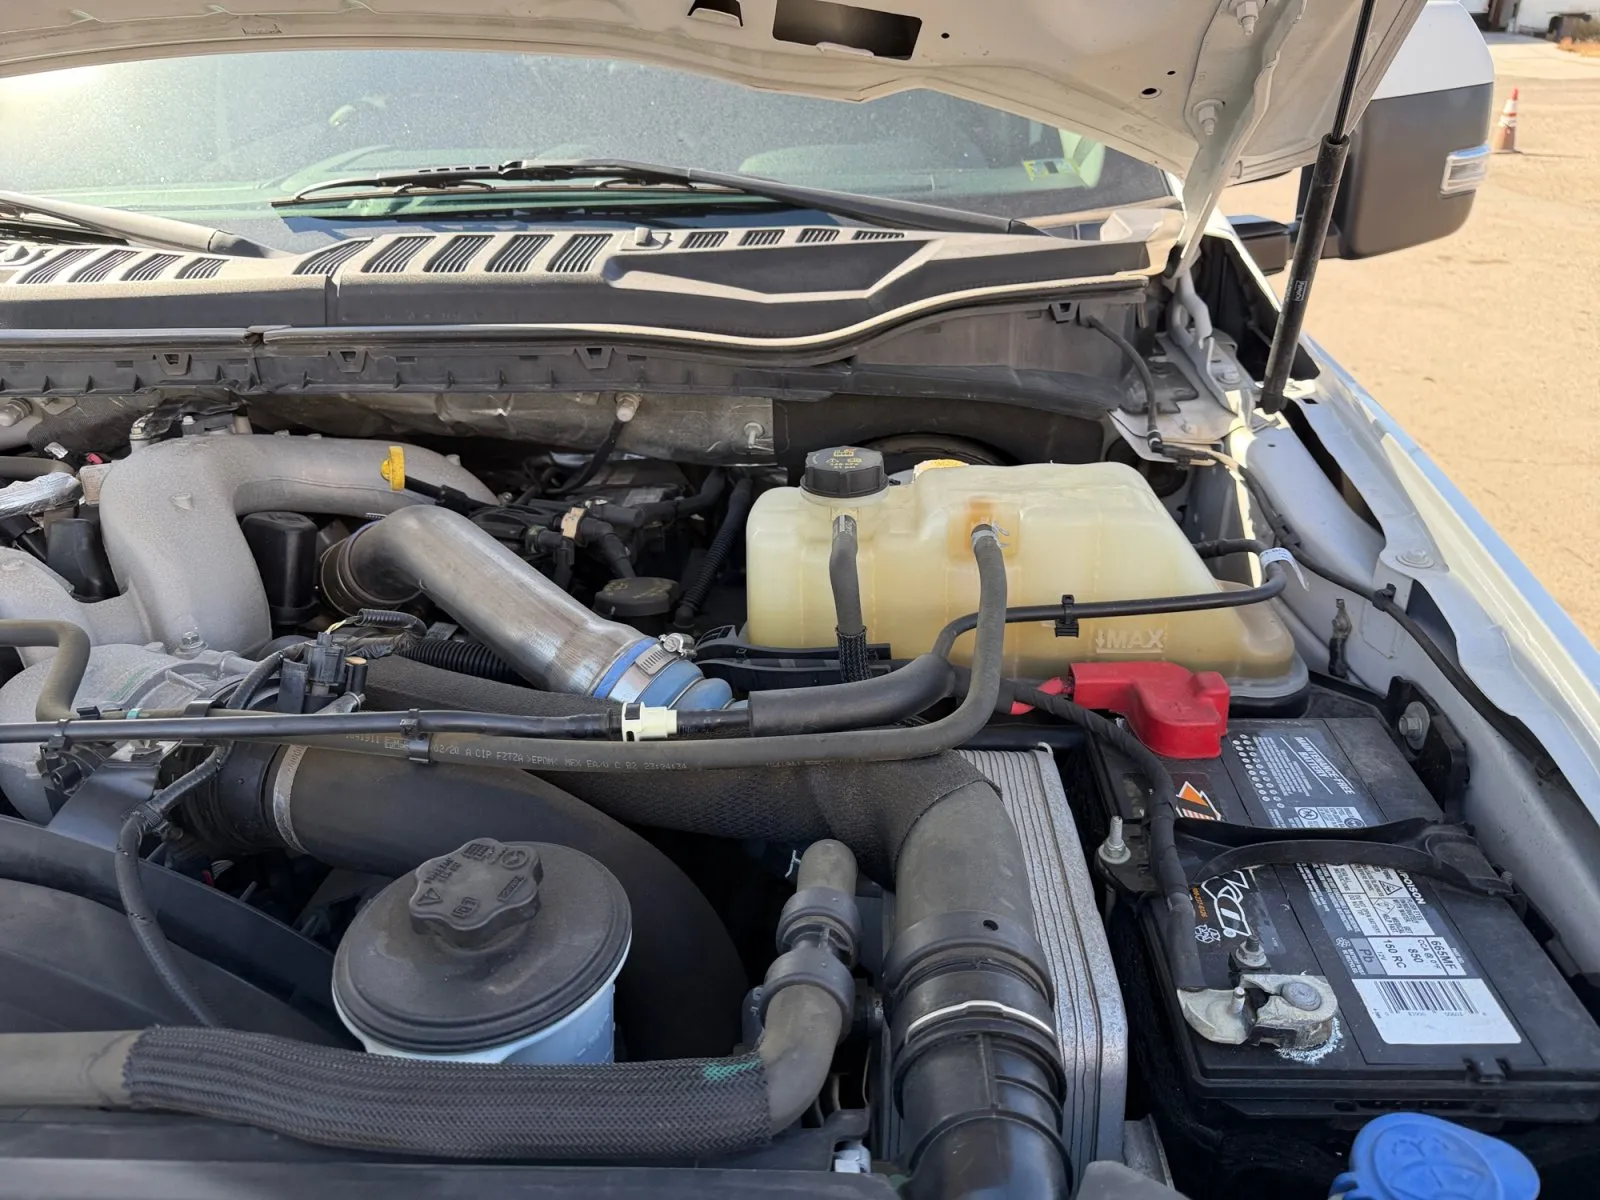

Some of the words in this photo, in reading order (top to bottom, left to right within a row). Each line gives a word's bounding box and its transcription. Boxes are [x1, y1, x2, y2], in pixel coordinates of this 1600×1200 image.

[1107, 628, 1163, 649] MAX
[1297, 752, 1329, 777] BATTERY
[1357, 948, 1376, 962] Pb
[1381, 939, 1398, 953] 150
[1391, 955, 1407, 968] RC
[1406, 948, 1424, 962] 850
[1416, 939, 1429, 950] CCA
[1429, 940, 1456, 969] 665MF
